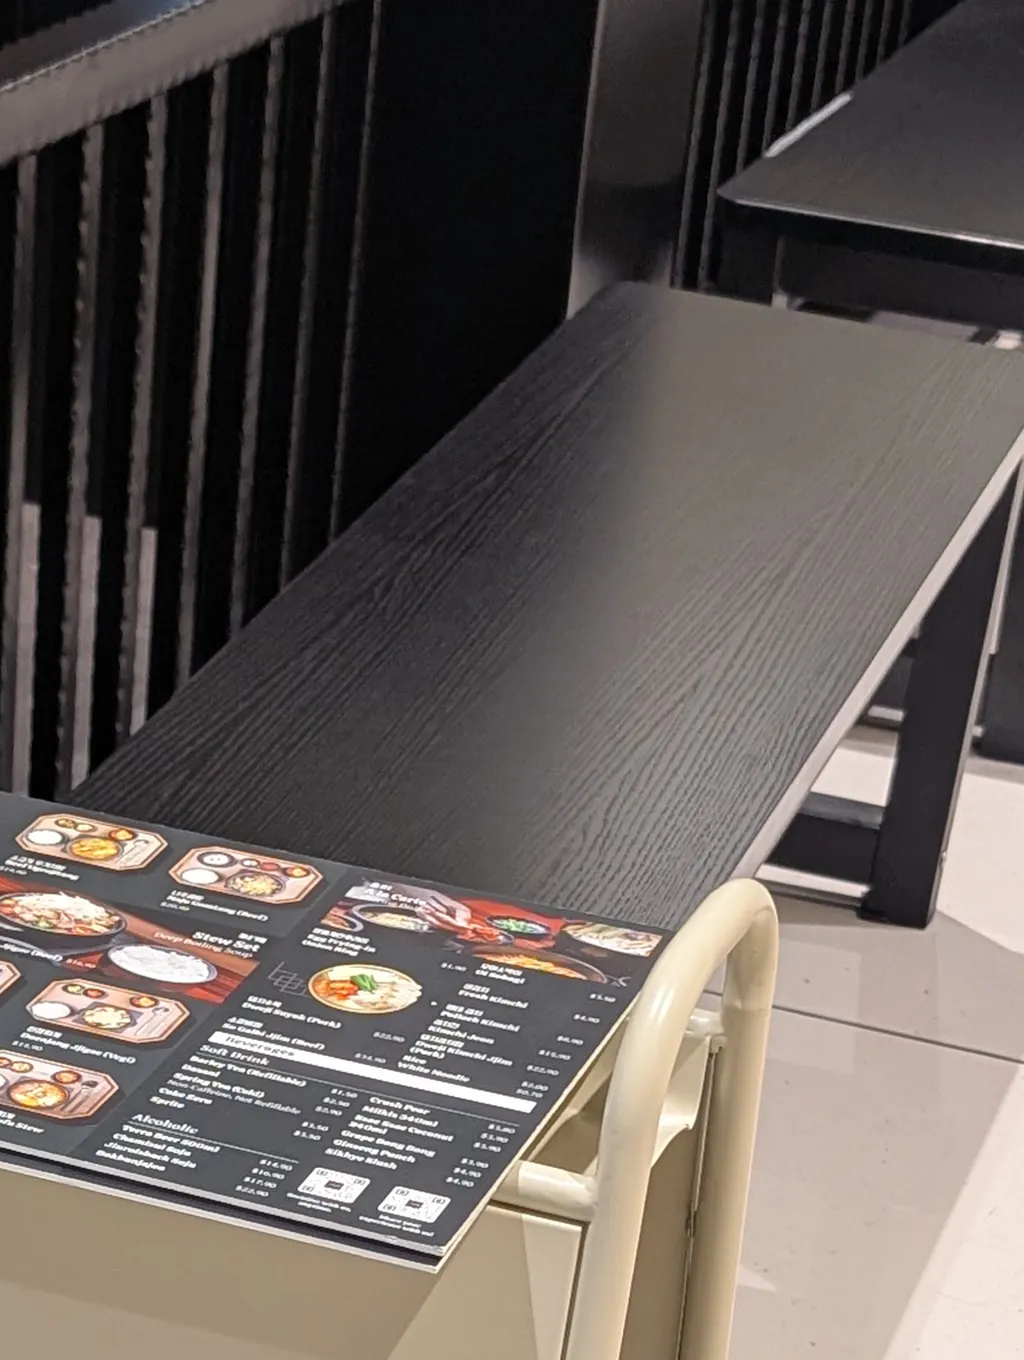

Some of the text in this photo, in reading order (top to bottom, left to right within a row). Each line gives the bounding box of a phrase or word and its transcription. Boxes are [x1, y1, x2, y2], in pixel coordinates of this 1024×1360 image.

[151, 931, 185, 943] Deep
[192, 931, 232, 945] Stew
[232, 940, 259, 951] Set
[200, 1045, 269, 1065] Soft Drink
[223, 1036, 296, 1058] Beverages
[132, 1114, 198, 1133] Alcoholic
